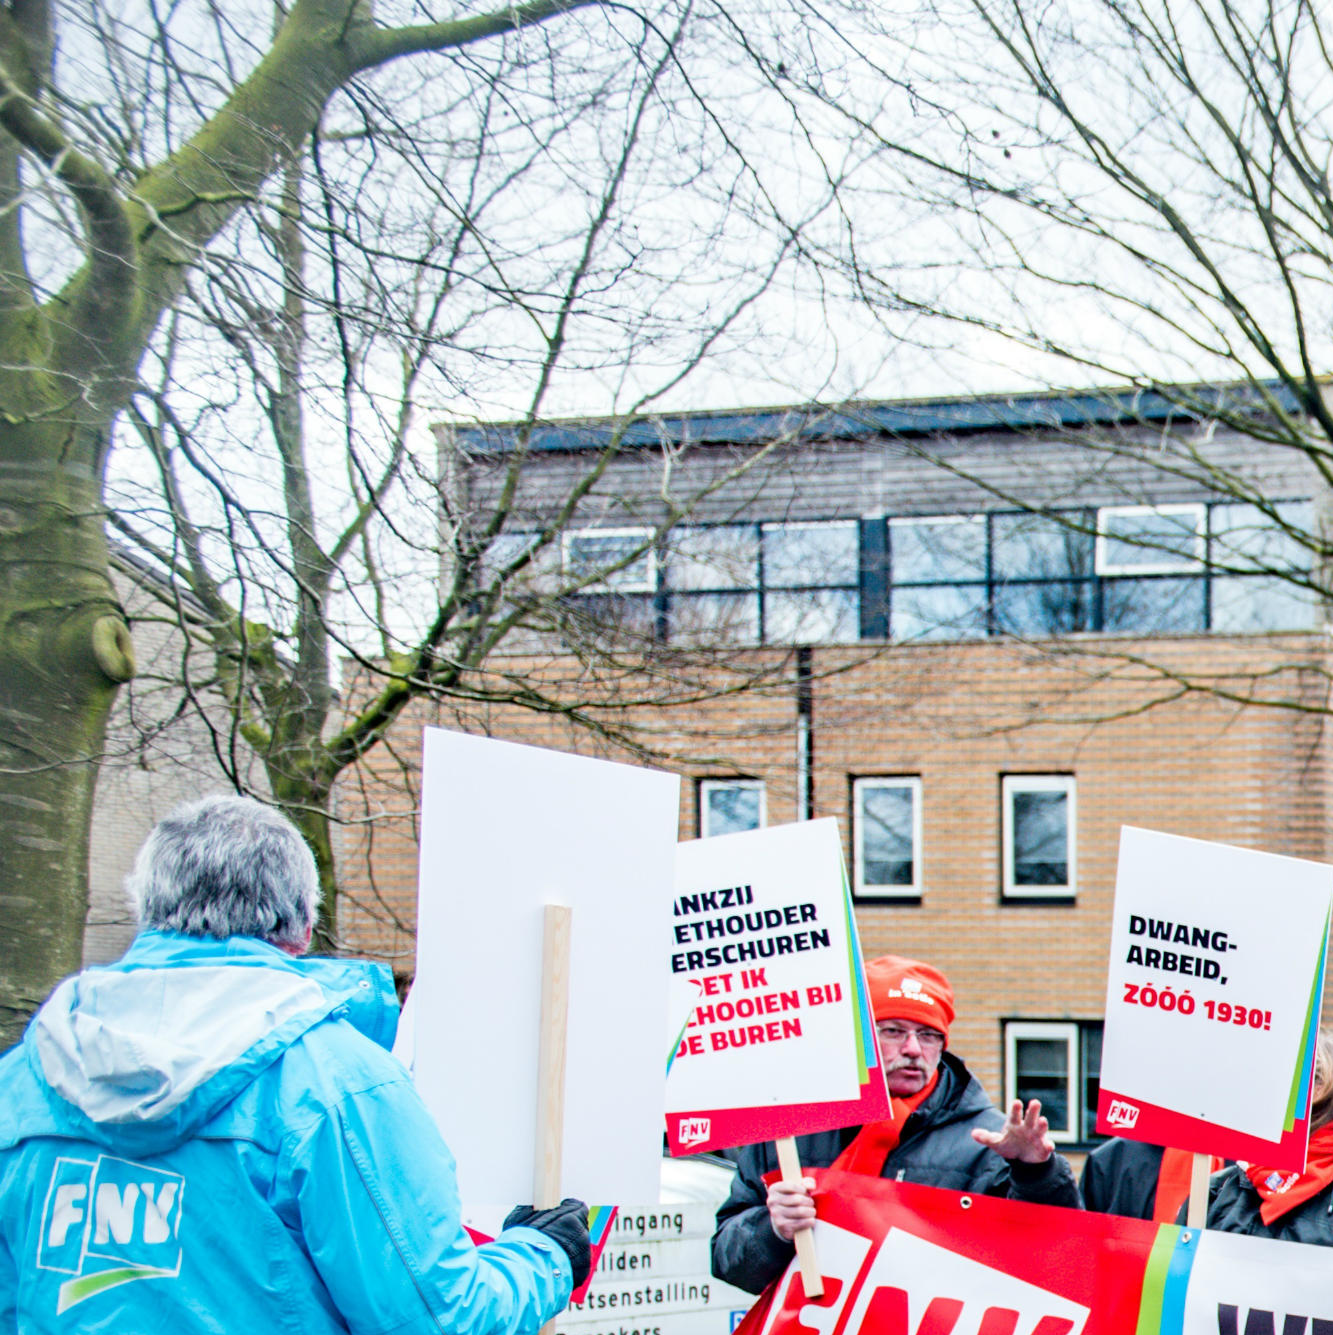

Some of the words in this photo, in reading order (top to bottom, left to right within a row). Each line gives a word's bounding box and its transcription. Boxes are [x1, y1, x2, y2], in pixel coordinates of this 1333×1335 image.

[672, 903, 817, 945] ETHOUDER
[1129, 914, 1237, 952] DWANG-
[672, 928, 830, 974] ERSCHUREN
[1126, 945, 1228, 985] ARBEID,
[742, 967, 768, 990] IK
[807, 983, 842, 1006] BIJ
[1123, 982, 1195, 1015] ZÓÓÓ
[1204, 1000, 1272, 1031] 1930!
[711, 1018, 802, 1052] BUREN
[680, 1121, 709, 1139] FNV
[1109, 1104, 1138, 1123] FNV
[48, 1183, 178, 1247] FNV
[595, 1251, 651, 1272] liden
